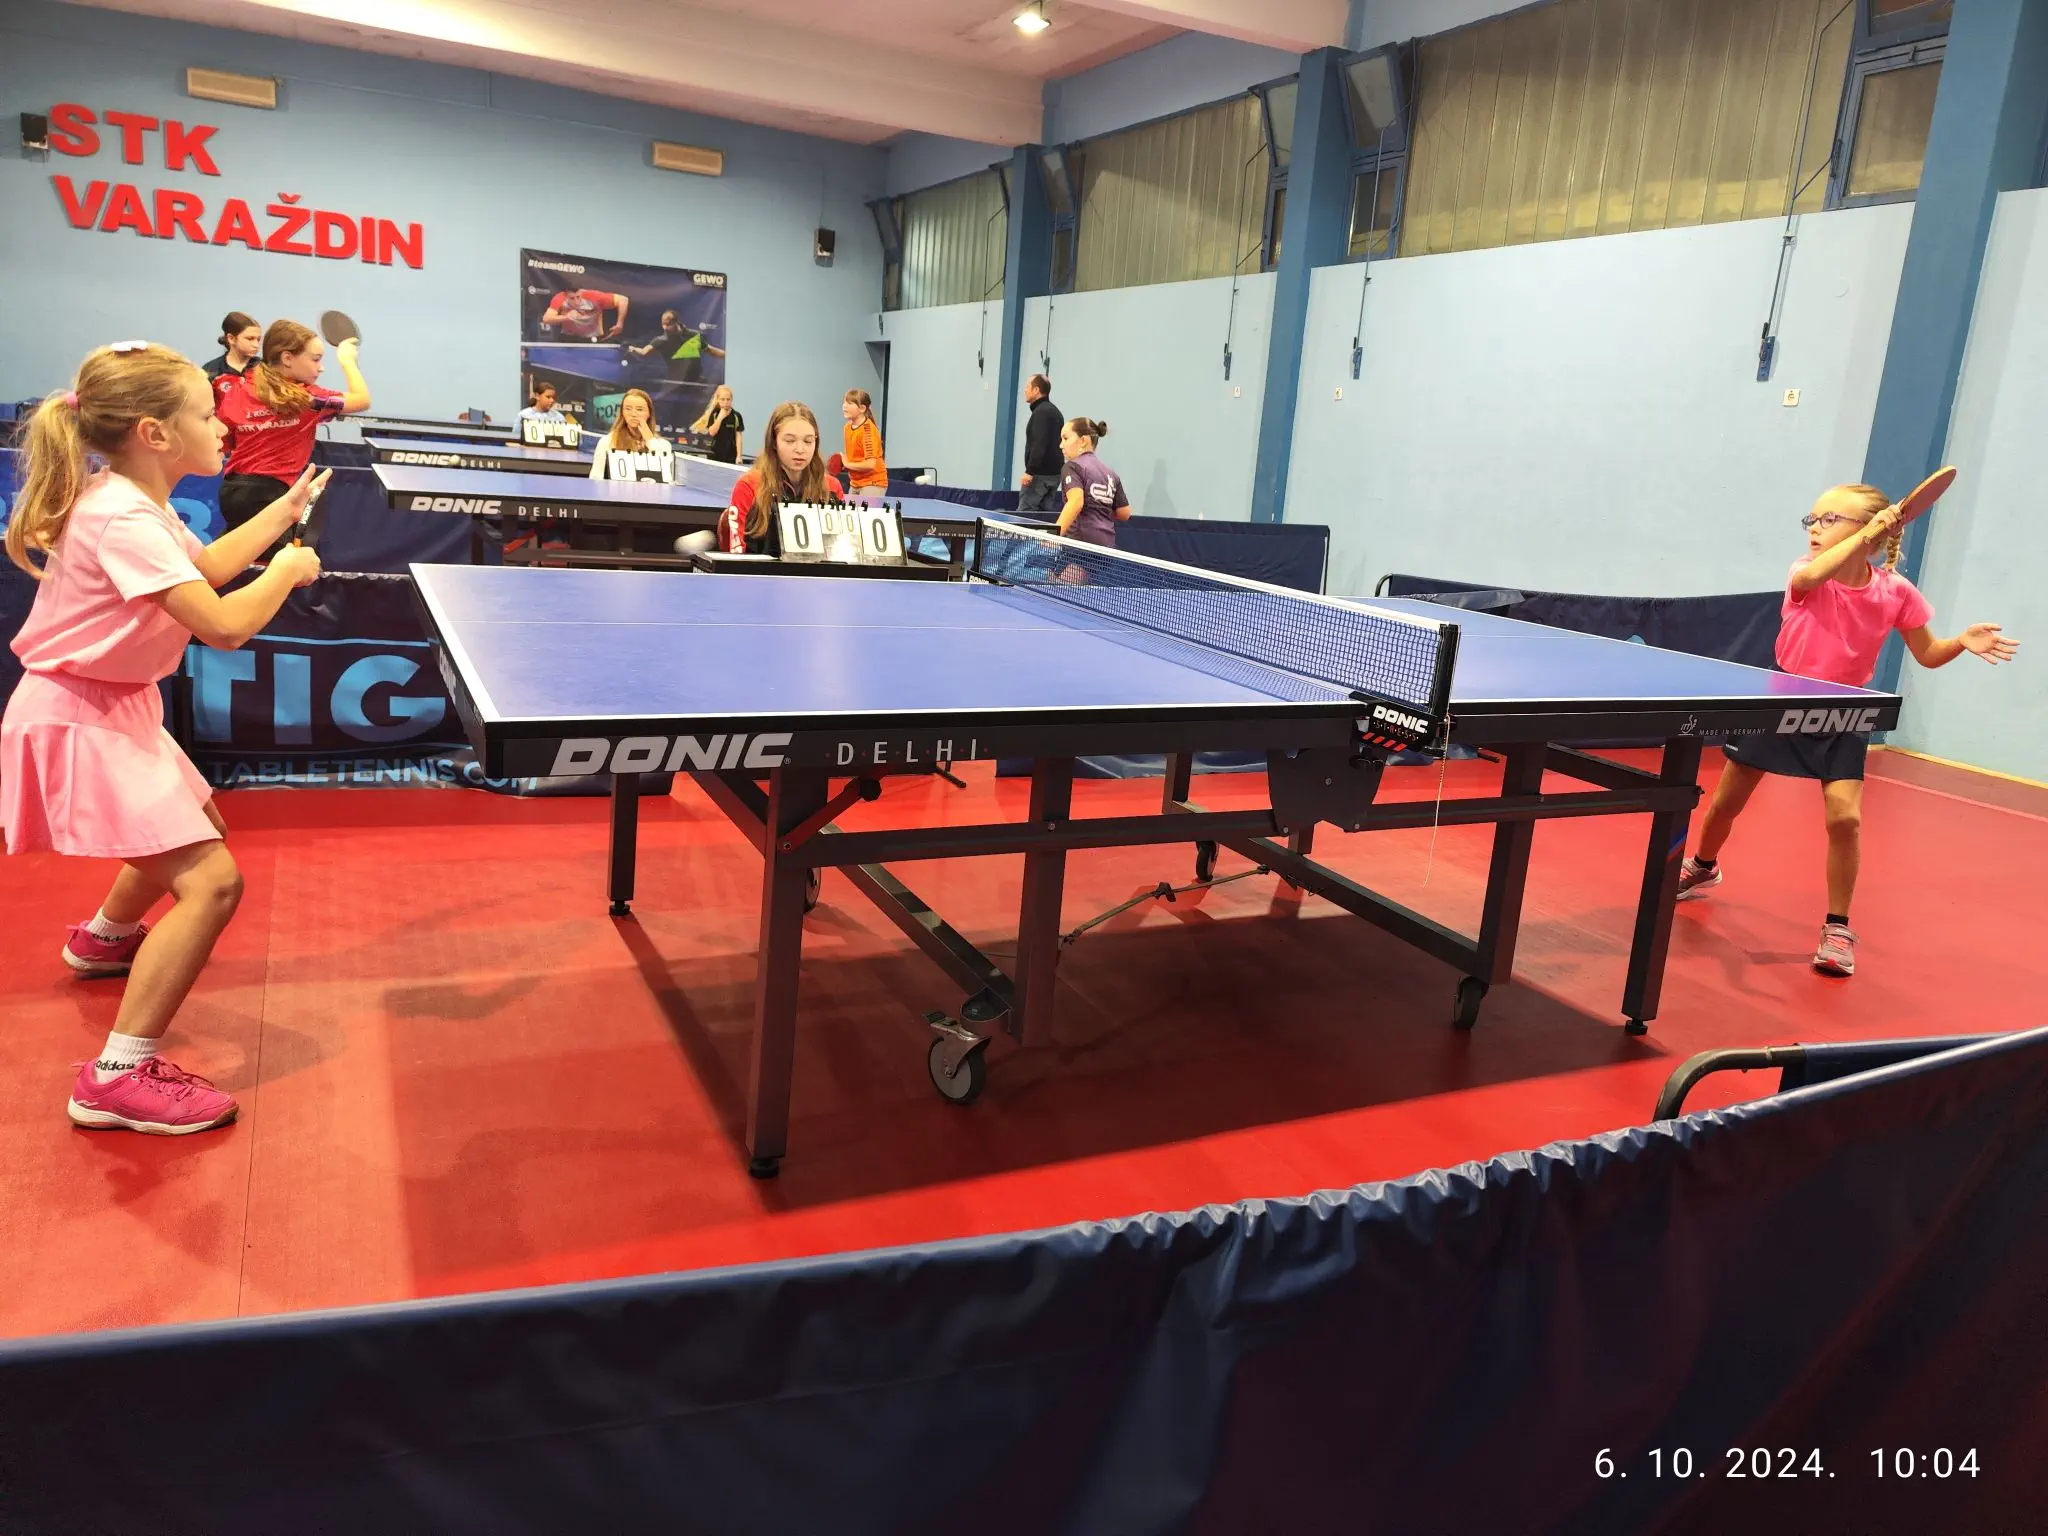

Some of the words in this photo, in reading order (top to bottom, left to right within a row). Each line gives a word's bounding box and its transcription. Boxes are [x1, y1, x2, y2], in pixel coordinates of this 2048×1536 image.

[49, 103, 221, 176] STK
[52, 174, 424, 269] VARAŽDIN
[528, 259, 585, 274] #teamGEWO
[693, 273, 724, 286] GEWO
[390, 452, 451, 466] DONIC
[460, 459, 501, 469] DELHI
[618, 458, 627, 478] 0
[410, 496, 502, 515] DONIC
[518, 505, 578, 519] DELHI
[793, 514, 810, 550] 0
[872, 518, 888, 553] 0
[1372, 704, 1429, 734] DONIC
[1775, 708, 1881, 734] DONIC
[1733, 728, 1767, 736] GERMANY
[549, 732, 794, 776] DONIC
[836, 738, 977, 766] DELHI
[95, 1059, 136, 1072] adidas
